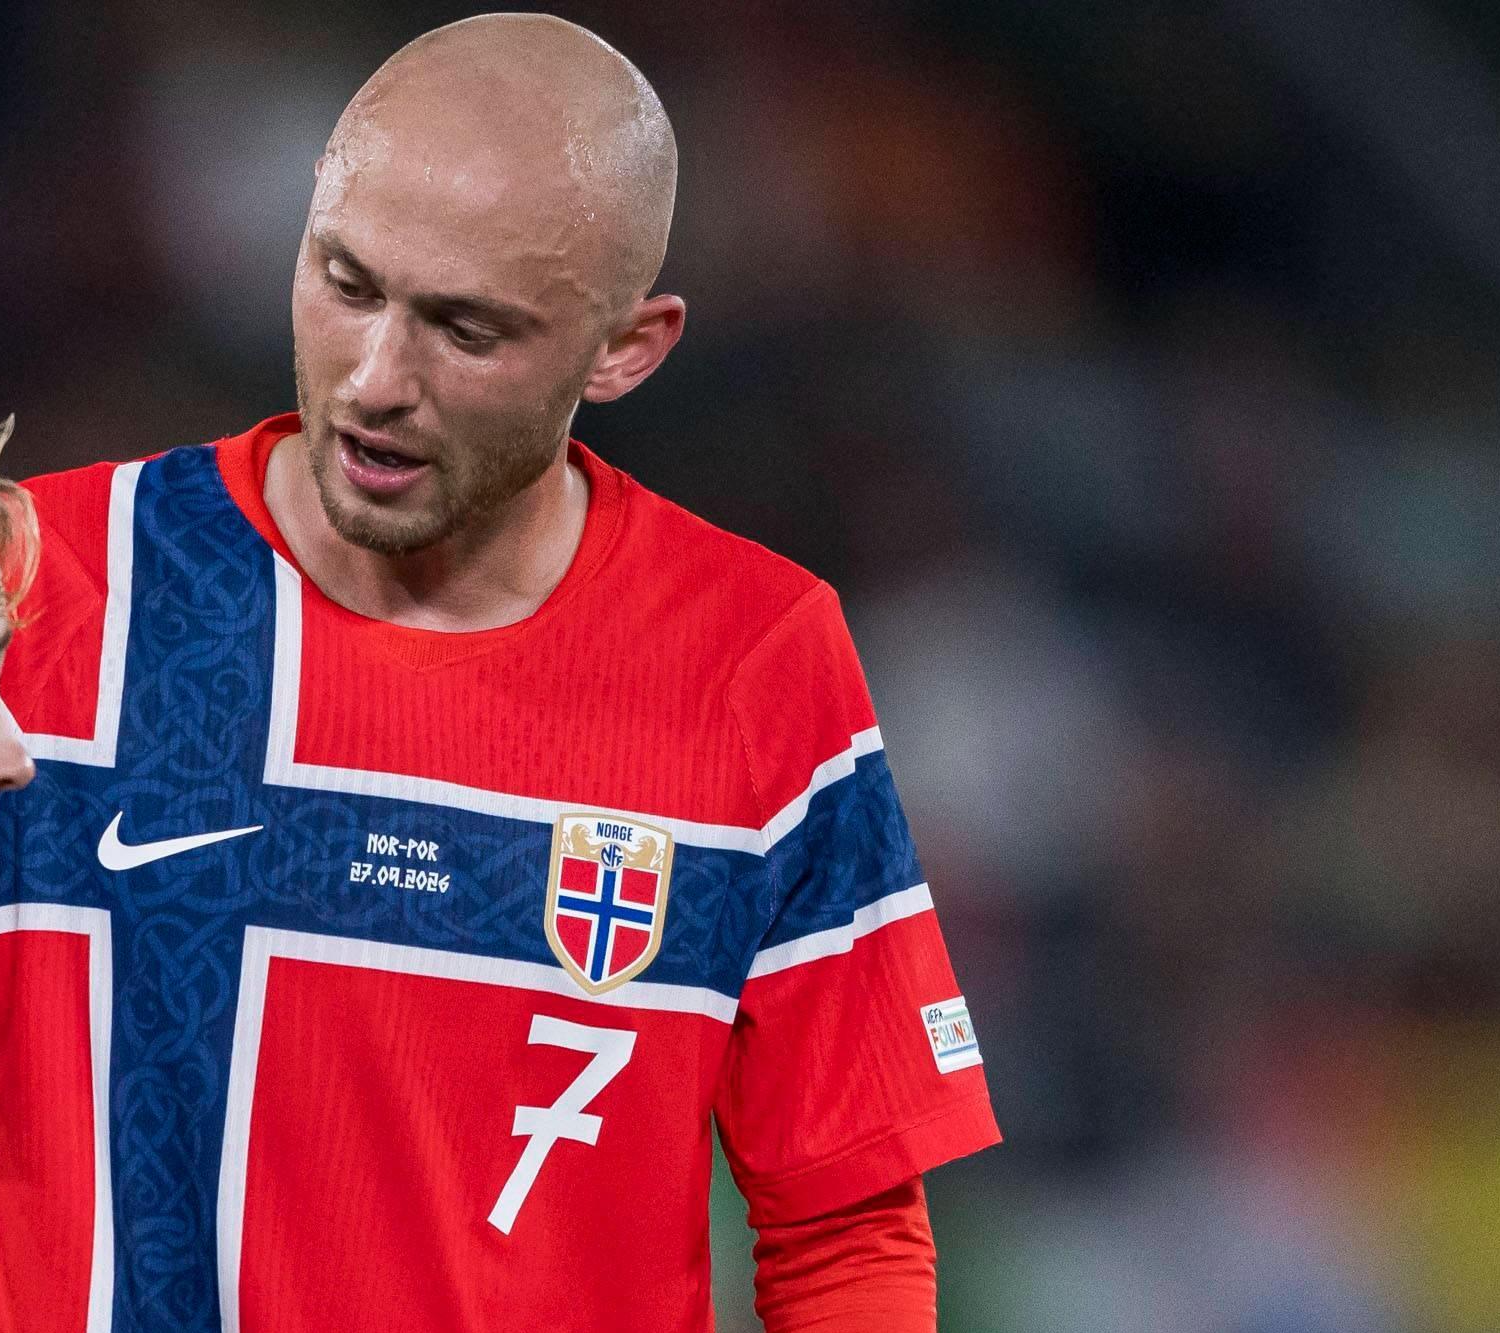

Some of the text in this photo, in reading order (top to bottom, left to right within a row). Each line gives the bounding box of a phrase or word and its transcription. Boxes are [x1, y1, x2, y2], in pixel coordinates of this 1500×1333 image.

[595, 821, 634, 842] NORGE
[366, 833, 440, 862] NOR-POR
[349, 861, 451, 893] 27.09.2026
[487, 1014, 638, 1236] 7
